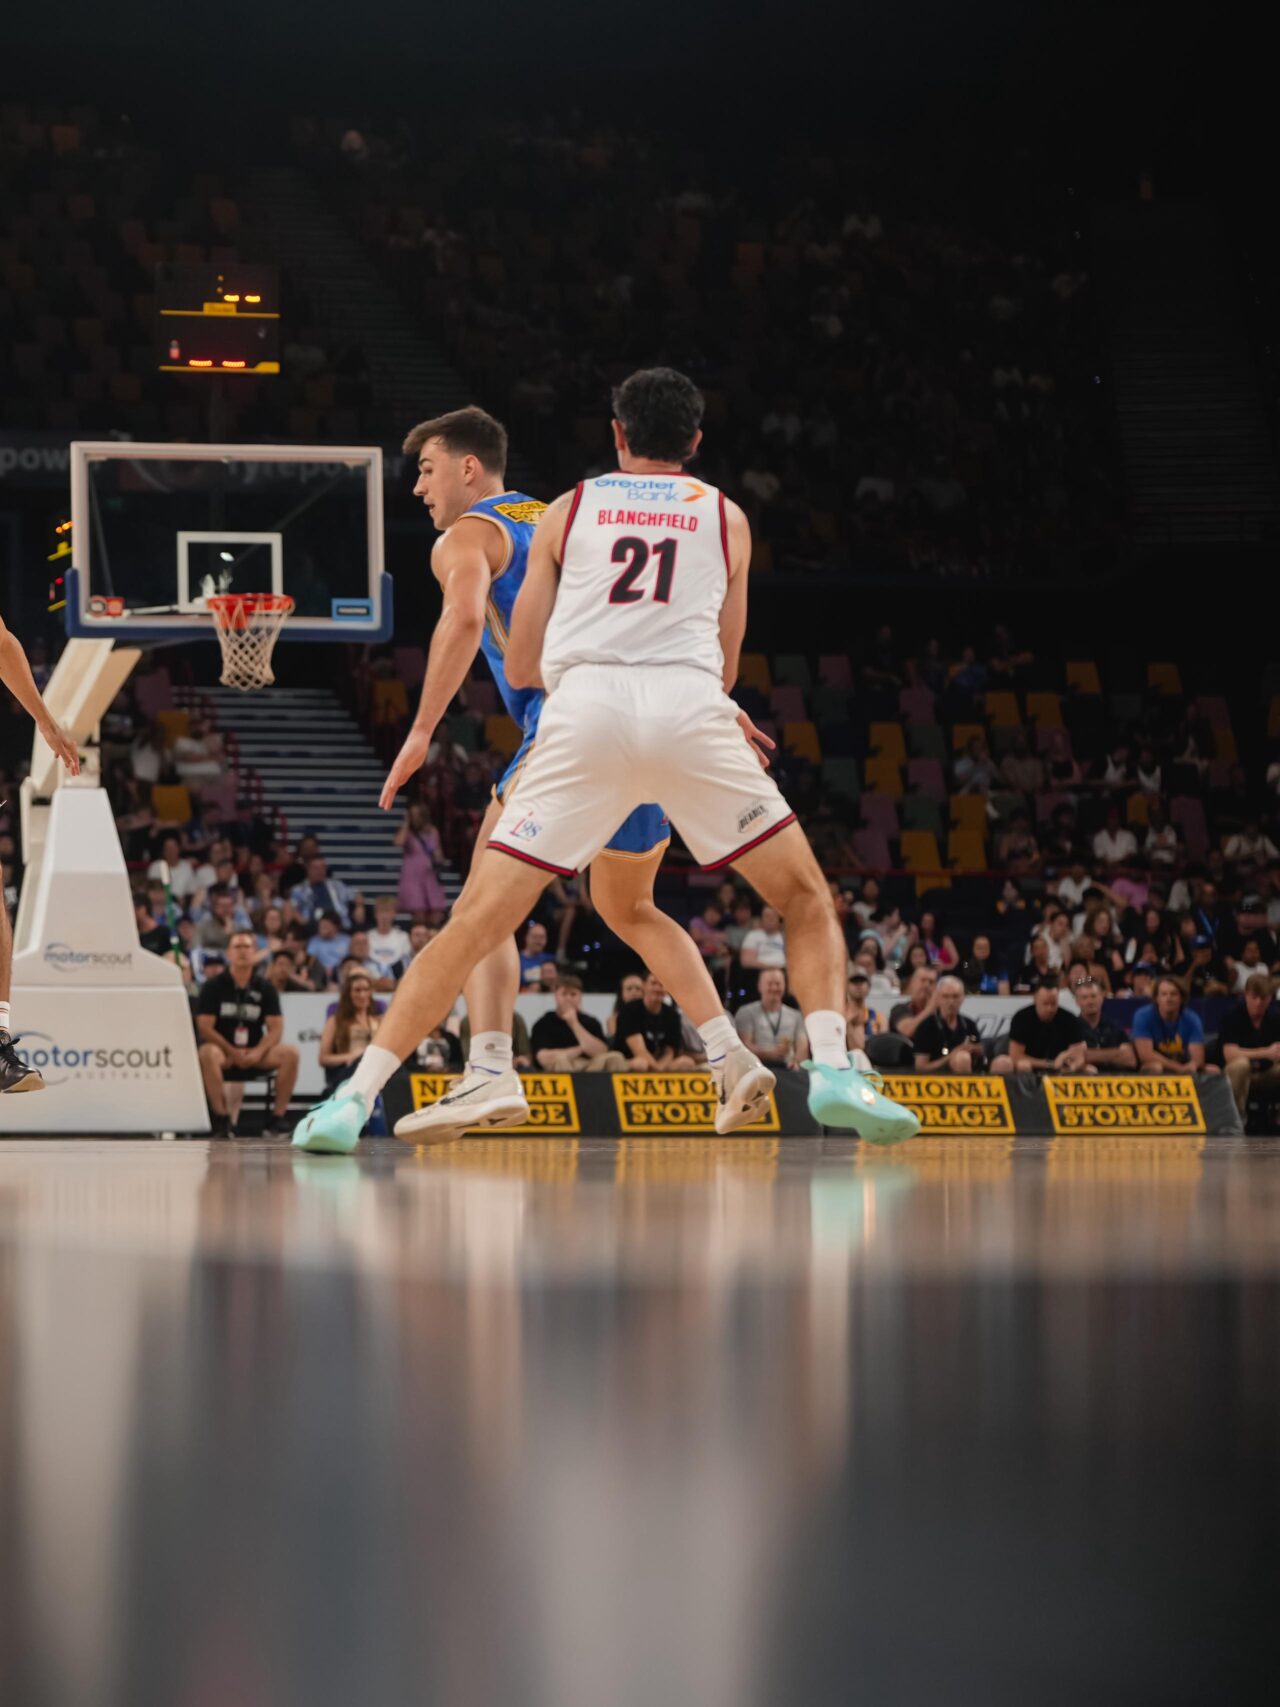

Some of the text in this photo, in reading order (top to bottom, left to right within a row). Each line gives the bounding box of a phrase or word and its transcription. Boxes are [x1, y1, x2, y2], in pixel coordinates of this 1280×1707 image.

[594, 478, 676, 490] Greater
[627, 488, 679, 501] Bank
[598, 509, 699, 532] BLANCHFIELD
[608, 536, 678, 604] 21
[44, 951, 133, 964] motorscout
[880, 1080, 1001, 1098] ATIONAL
[1053, 1081, 1191, 1099] NATIONAL
[1062, 1104, 1193, 1126] STORAGE
